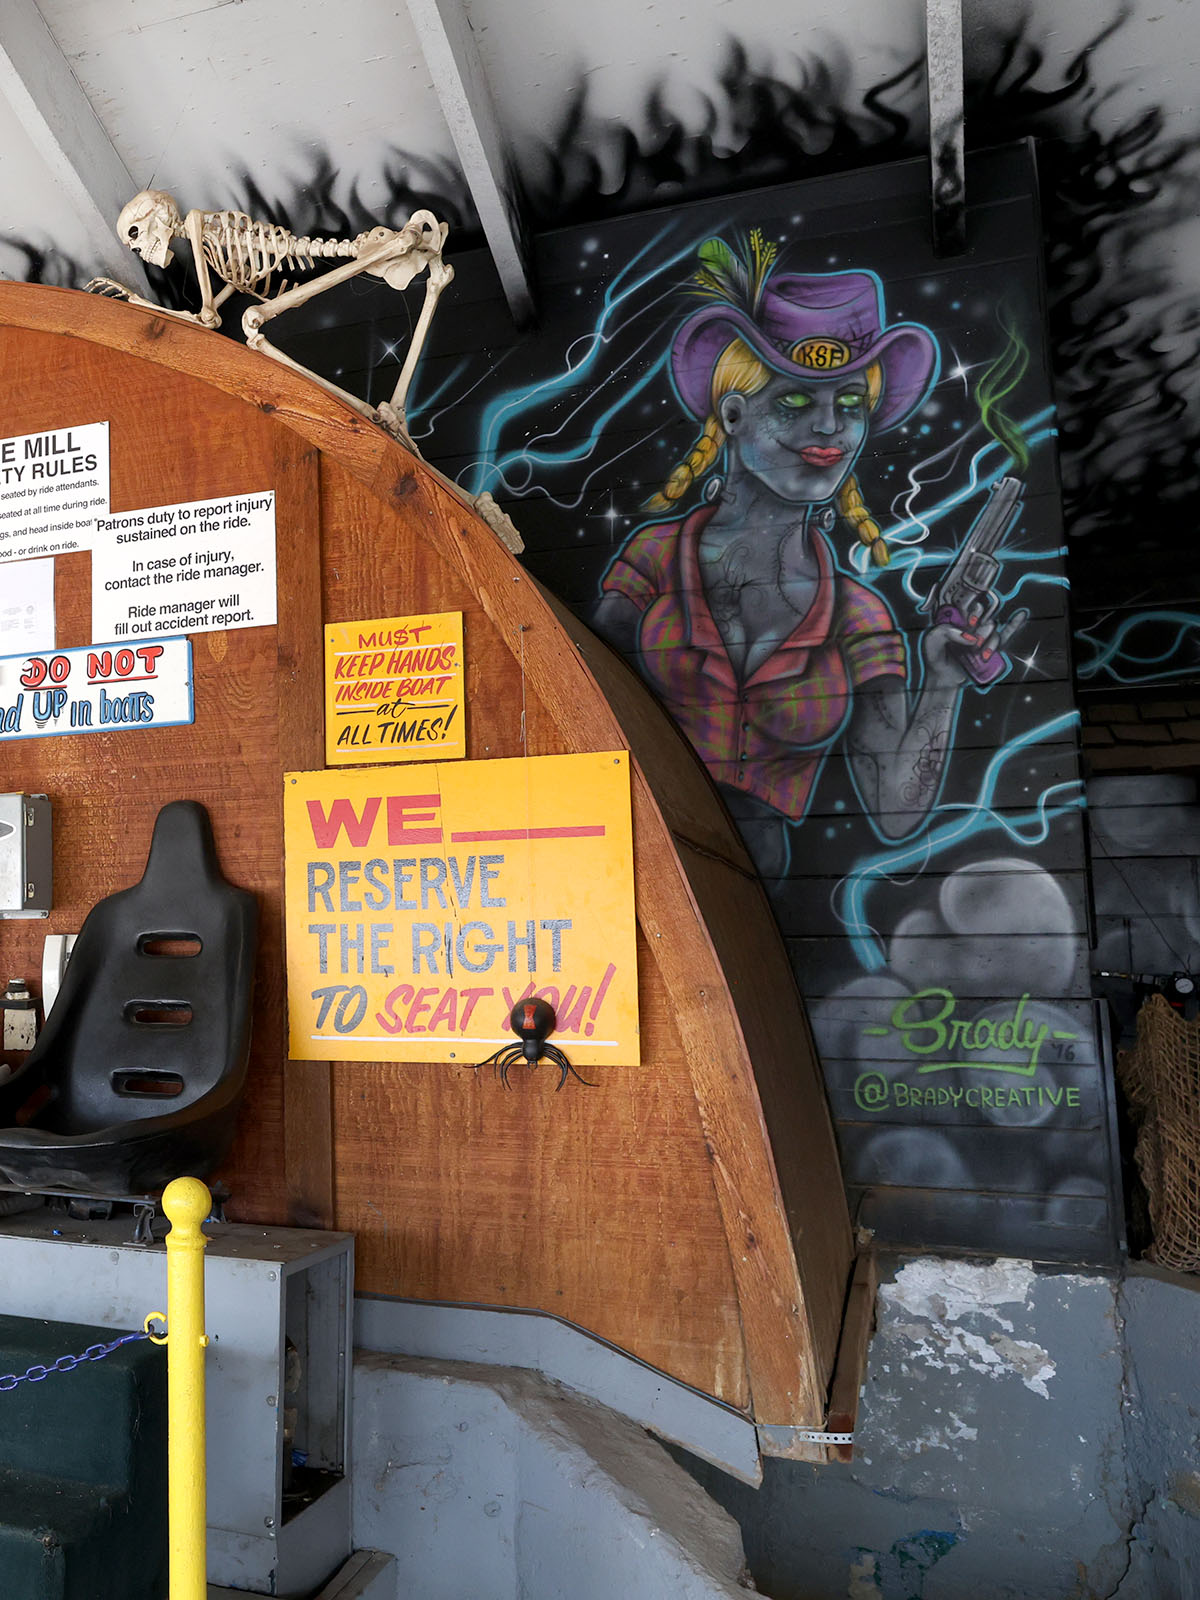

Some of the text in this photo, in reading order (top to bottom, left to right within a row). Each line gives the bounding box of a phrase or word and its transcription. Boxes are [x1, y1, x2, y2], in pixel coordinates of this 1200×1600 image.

[24, 432, 81, 460] MILL
[32, 454, 98, 479] RULES
[0, 488, 26, 500] seated
[28, 486, 38, 497] by
[39, 484, 54, 494] ride
[56, 478, 100, 492] attendants.
[24, 507, 32, 516] at
[33, 504, 42, 514] all
[44, 502, 60, 513] time
[62, 498, 88, 511] during
[90, 495, 108, 506] ride.
[97, 497, 272, 532] Patrons duty to report injury
[12, 526, 28, 537] and
[28, 522, 48, 534] head
[50, 518, 74, 531] inside
[116, 516, 251, 544] sustained on the ride.
[18, 548, 26, 556] or
[28, 544, 48, 554] drink
[50, 542, 60, 551] on
[62, 540, 80, 550] ride.
[132, 550, 235, 572] In case of injury,
[104, 562, 264, 590] contact the ride manager.
[128, 594, 240, 618] Ride manager will
[114, 609, 254, 635] fill out accident report.
[358, 625, 432, 648] MUST
[20, 655, 71, 687] DO
[88, 646, 164, 678] NOT
[334, 646, 456, 680] KEEP HANDS
[336, 676, 452, 702] INSIDE BOAT
[32, 689, 68, 721] UP
[70, 700, 93, 727] in
[100, 688, 154, 724] boats
[376, 698, 415, 718] at
[337, 704, 458, 746] ALL TIMES!
[306, 794, 442, 849] WE
[307, 854, 507, 913] RESERVE
[308, 919, 572, 975] THE RIGHT
[311, 984, 367, 1034] TO
[376, 983, 494, 1034] SEAT
[854, 1071, 1080, 1112] @BRADYCREATIVE
